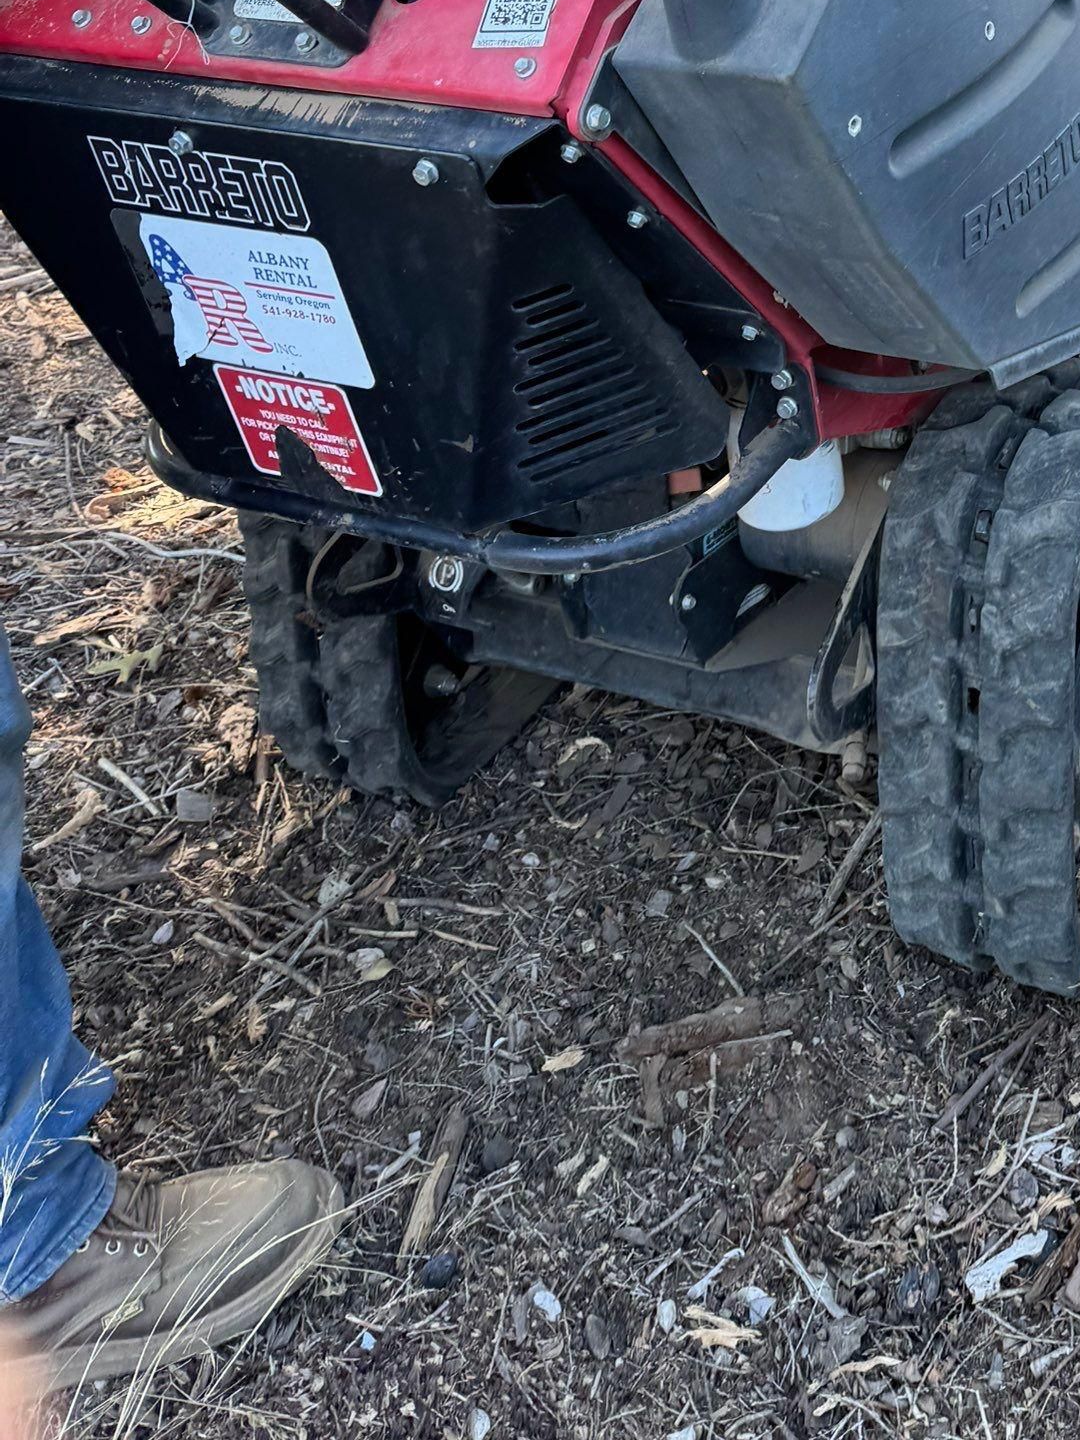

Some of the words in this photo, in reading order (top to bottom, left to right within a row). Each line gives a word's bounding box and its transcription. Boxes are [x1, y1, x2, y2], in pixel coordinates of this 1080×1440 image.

[86, 135, 312, 232] BARRETO
[248, 249, 310, 271] ALBANY
[253, 267, 318, 289] RENTAL
[256, 289, 294, 305] Serving
[295, 296, 331, 310] Oregon
[262, 304, 337, 324] 541-928-1780
[273, 342, 303, 358] INC.
[240, 416, 257, 428] FOR
[297, 428, 316, 441] THIS
[258, 409, 276, 421] YOU
[275, 412, 297, 425] NEED
[297, 416, 309, 427] TO
[258, 431, 271, 443] OR
